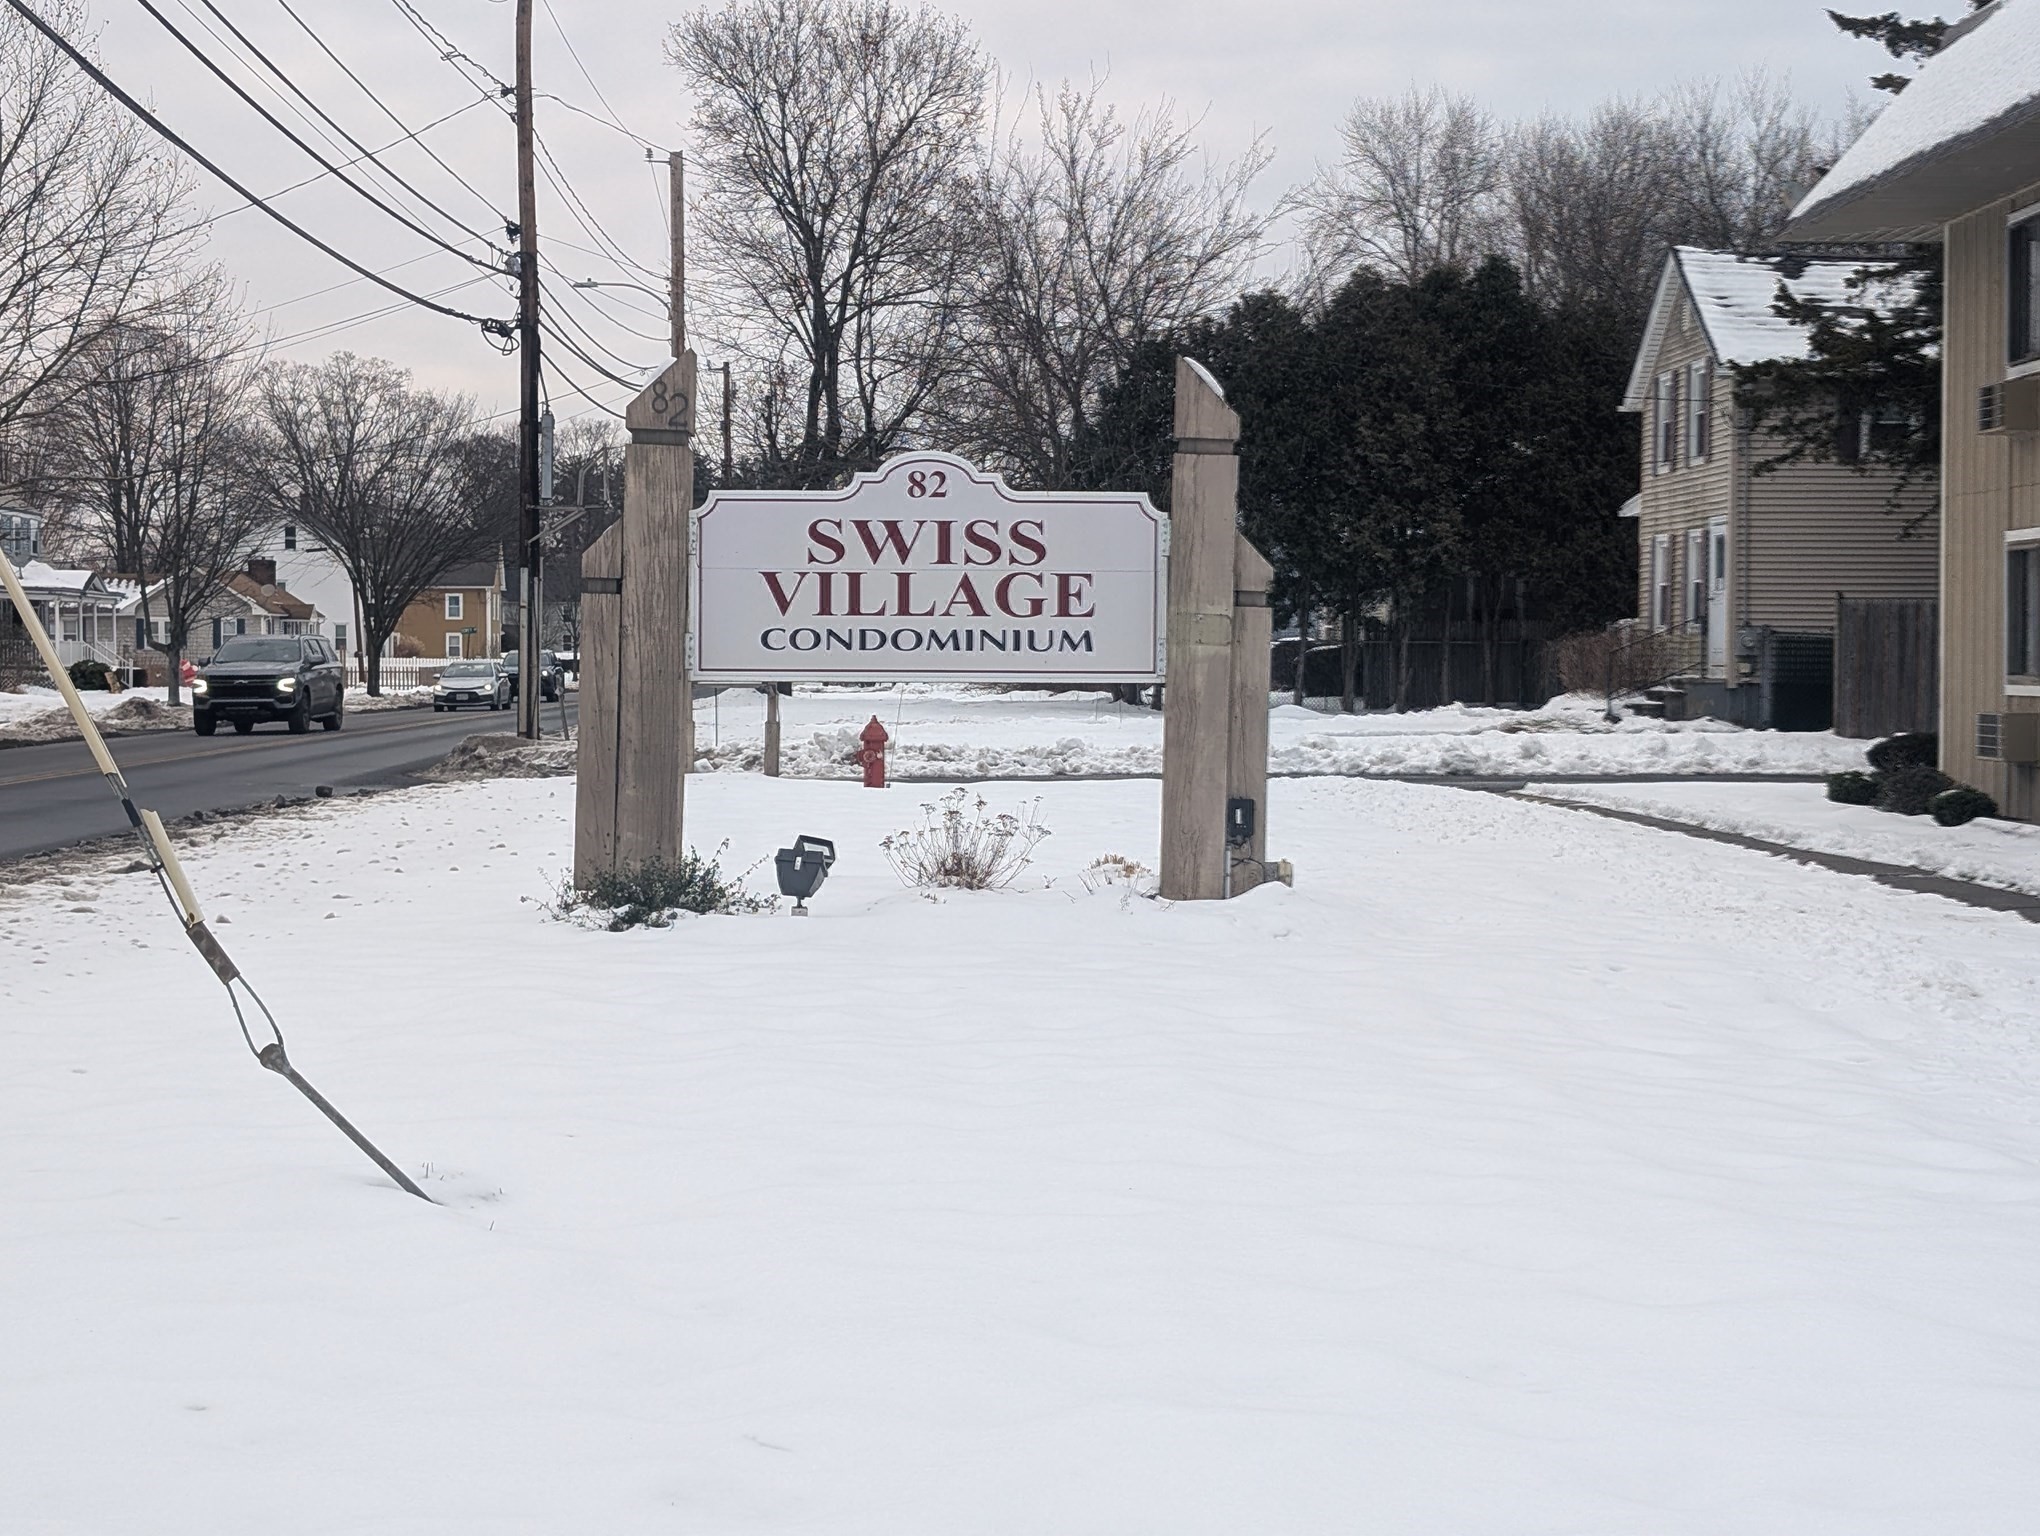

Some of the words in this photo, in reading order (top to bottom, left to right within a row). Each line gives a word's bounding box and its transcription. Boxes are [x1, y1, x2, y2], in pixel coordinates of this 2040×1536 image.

[652, 379, 689, 427] 82
[907, 470, 948, 499] 82
[806, 518, 1048, 567] SWISS
[758, 571, 1096, 619] VILLAGE
[759, 627, 1094, 653] CONDOMINIUM
